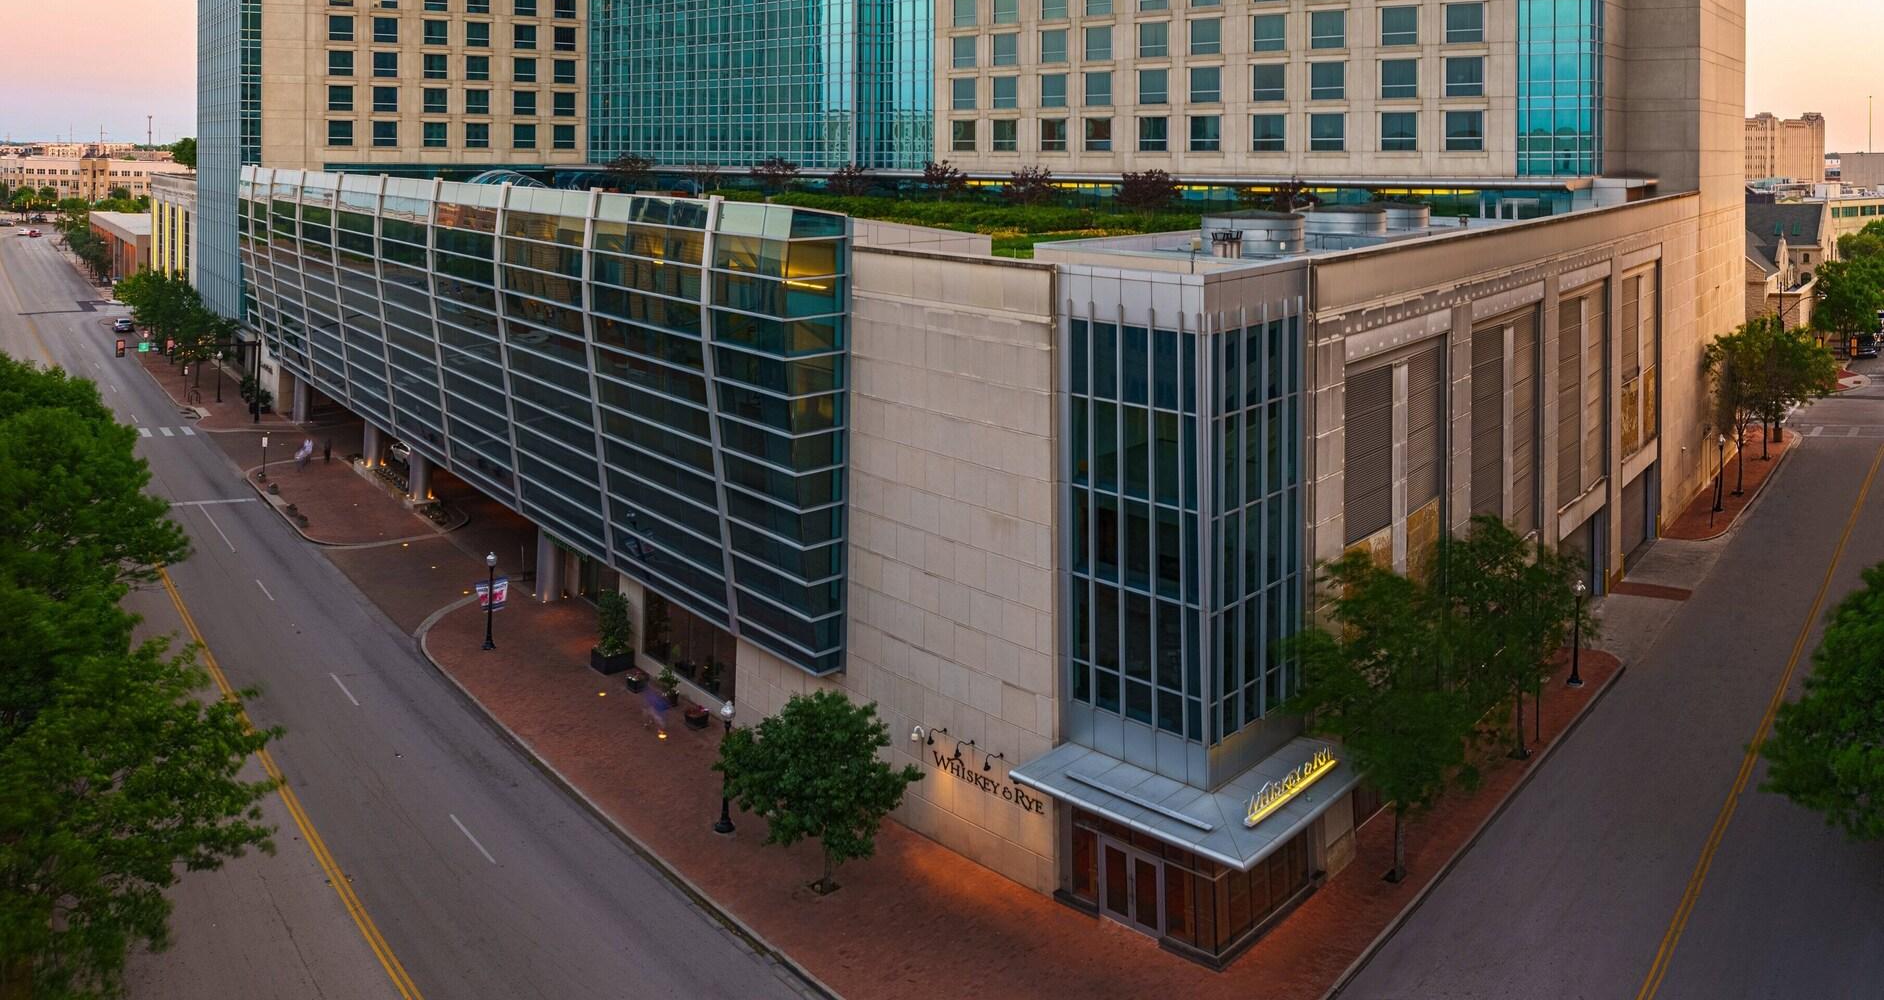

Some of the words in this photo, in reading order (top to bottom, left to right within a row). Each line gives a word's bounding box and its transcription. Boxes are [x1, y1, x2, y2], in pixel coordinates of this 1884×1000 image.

[933, 750, 1000, 795] WHISKEY
[1002, 786, 1013, 801] &
[1014, 787, 1045, 815] RYE
